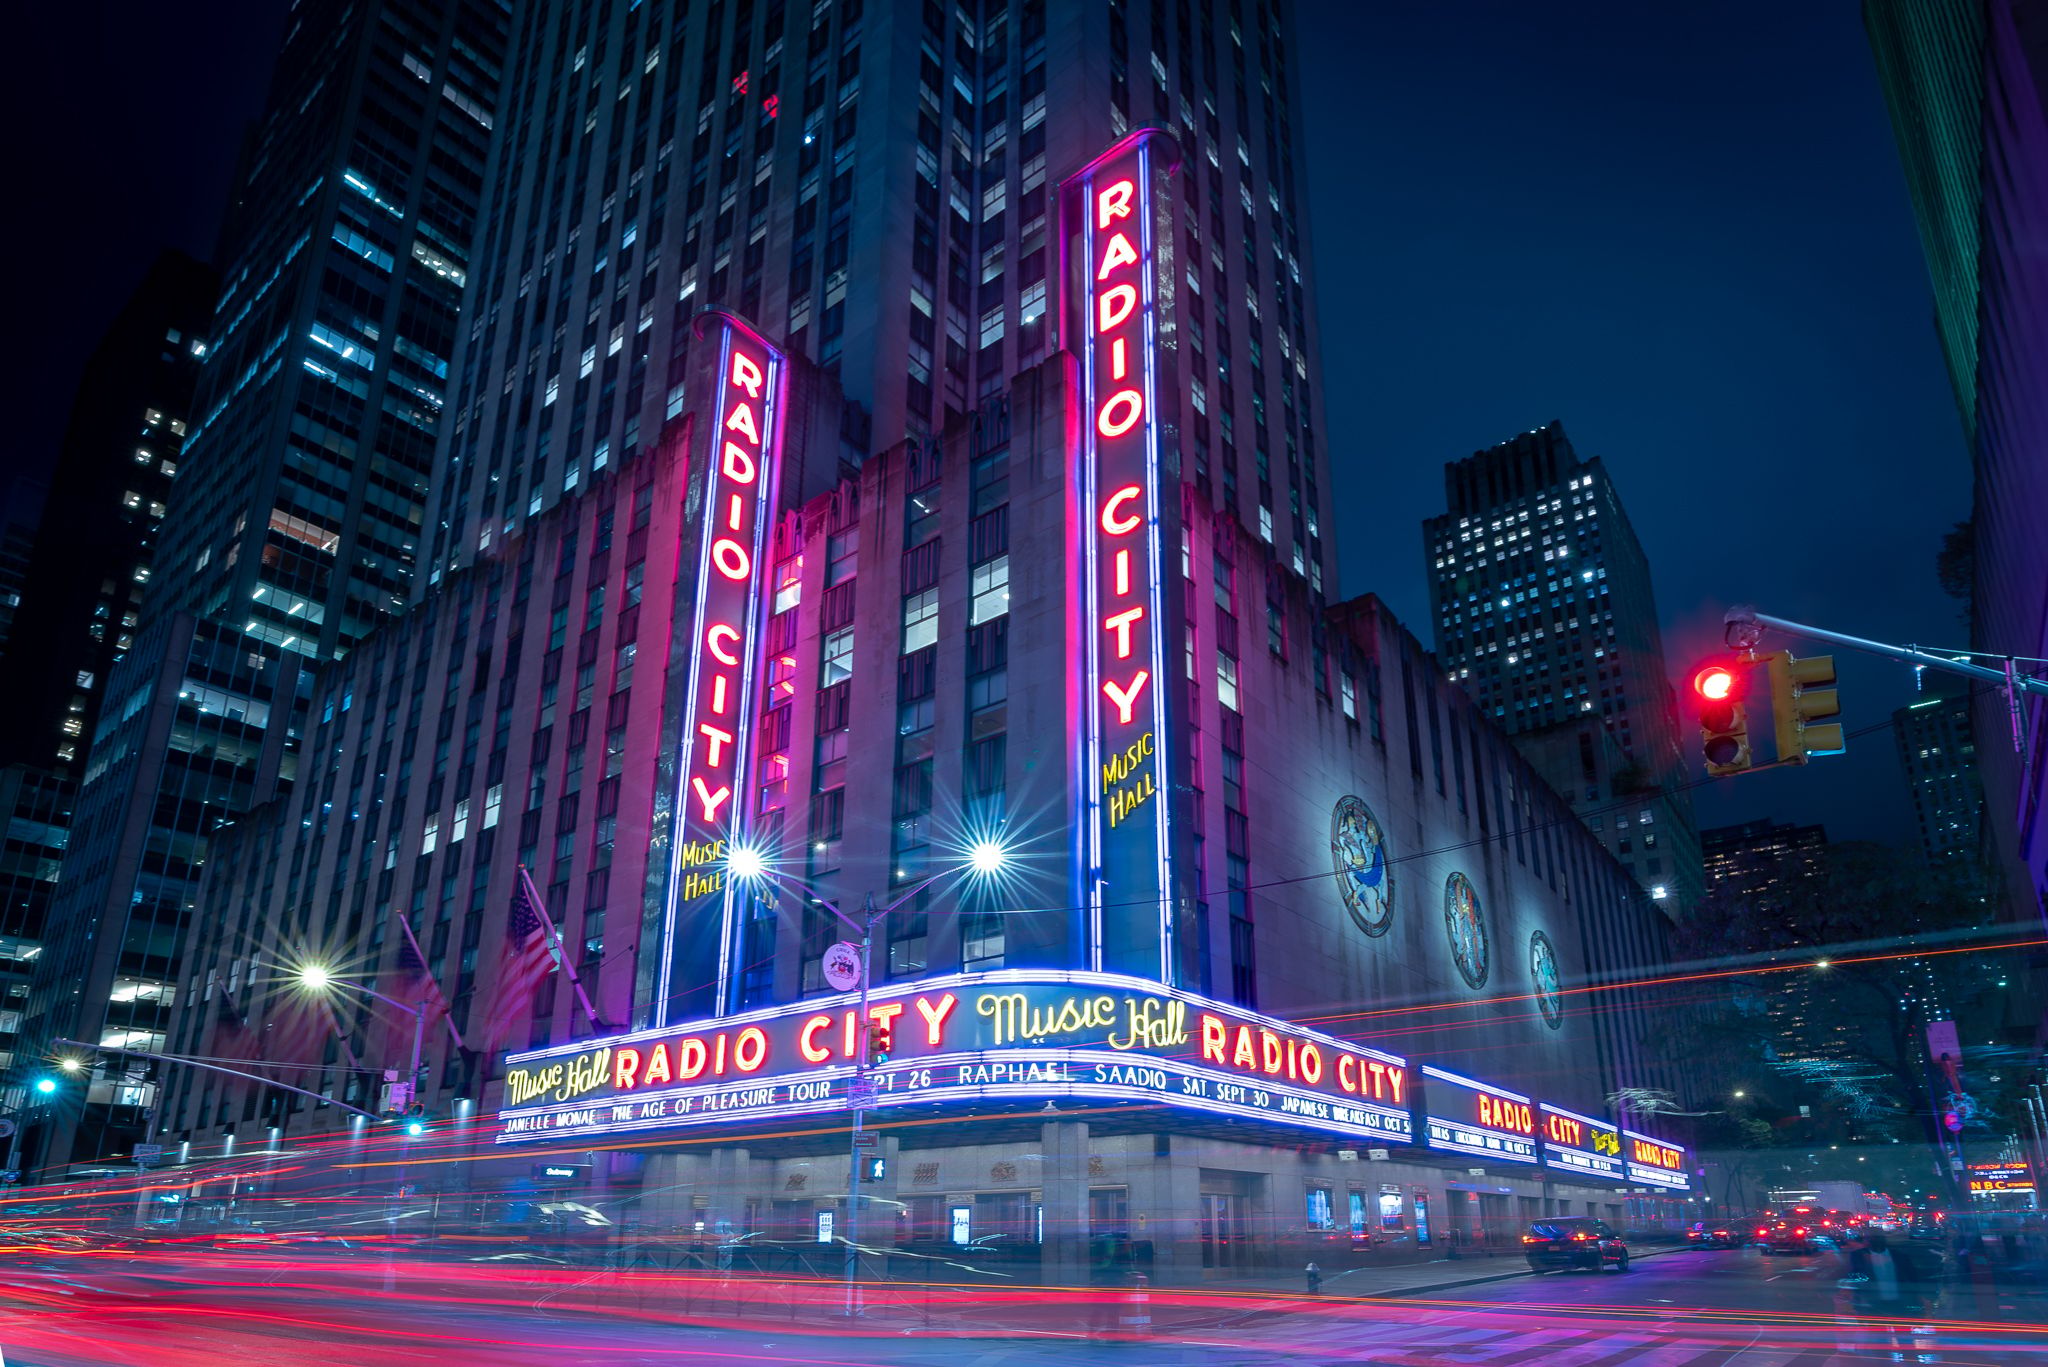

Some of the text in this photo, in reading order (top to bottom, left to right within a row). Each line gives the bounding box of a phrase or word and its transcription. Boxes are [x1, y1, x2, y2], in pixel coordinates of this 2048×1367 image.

[1097, 179, 1149, 724] RADIO CITY
[692, 351, 763, 822] RADIO CITY
[1103, 732, 1154, 795] MUSIC
[1111, 773, 1156, 828] HALL
[681, 839, 726, 870] MUSIC
[684, 871, 723, 902] HALL
[614, 993, 957, 1089] RADIO CITY
[976, 993, 1188, 1051] Music Hall
[507, 1046, 612, 1106] Music Hall
[958, 1062, 1270, 1108] RAPHAEL SAADIQ SAT. SEPT 30
[1202, 1014, 1404, 1104] RADIO CITY
[504, 1115, 550, 1134] JANELLE
[556, 1109, 597, 1127] MONAE
[612, 1105, 633, 1121] THE
[640, 1101, 666, 1118] AGE
[674, 1097, 694, 1114] OF
[702, 1086, 777, 1111] PLEASURE
[788, 1081, 831, 1102] TOUR
[908, 1069, 932, 1089] 26
[1281, 1096, 1330, 1120] JAPANESE
[1332, 1106, 1381, 1129] BREAKFAST
[1384, 1116, 1401, 1132] OCT
[1478, 1093, 1532, 1134] RADIO
[1549, 1115, 1581, 1146] CITY
[1634, 1140, 1662, 1166] RADIO
[1661, 1147, 1680, 1170] CITY
[1970, 1181, 2006, 1190] NBC
